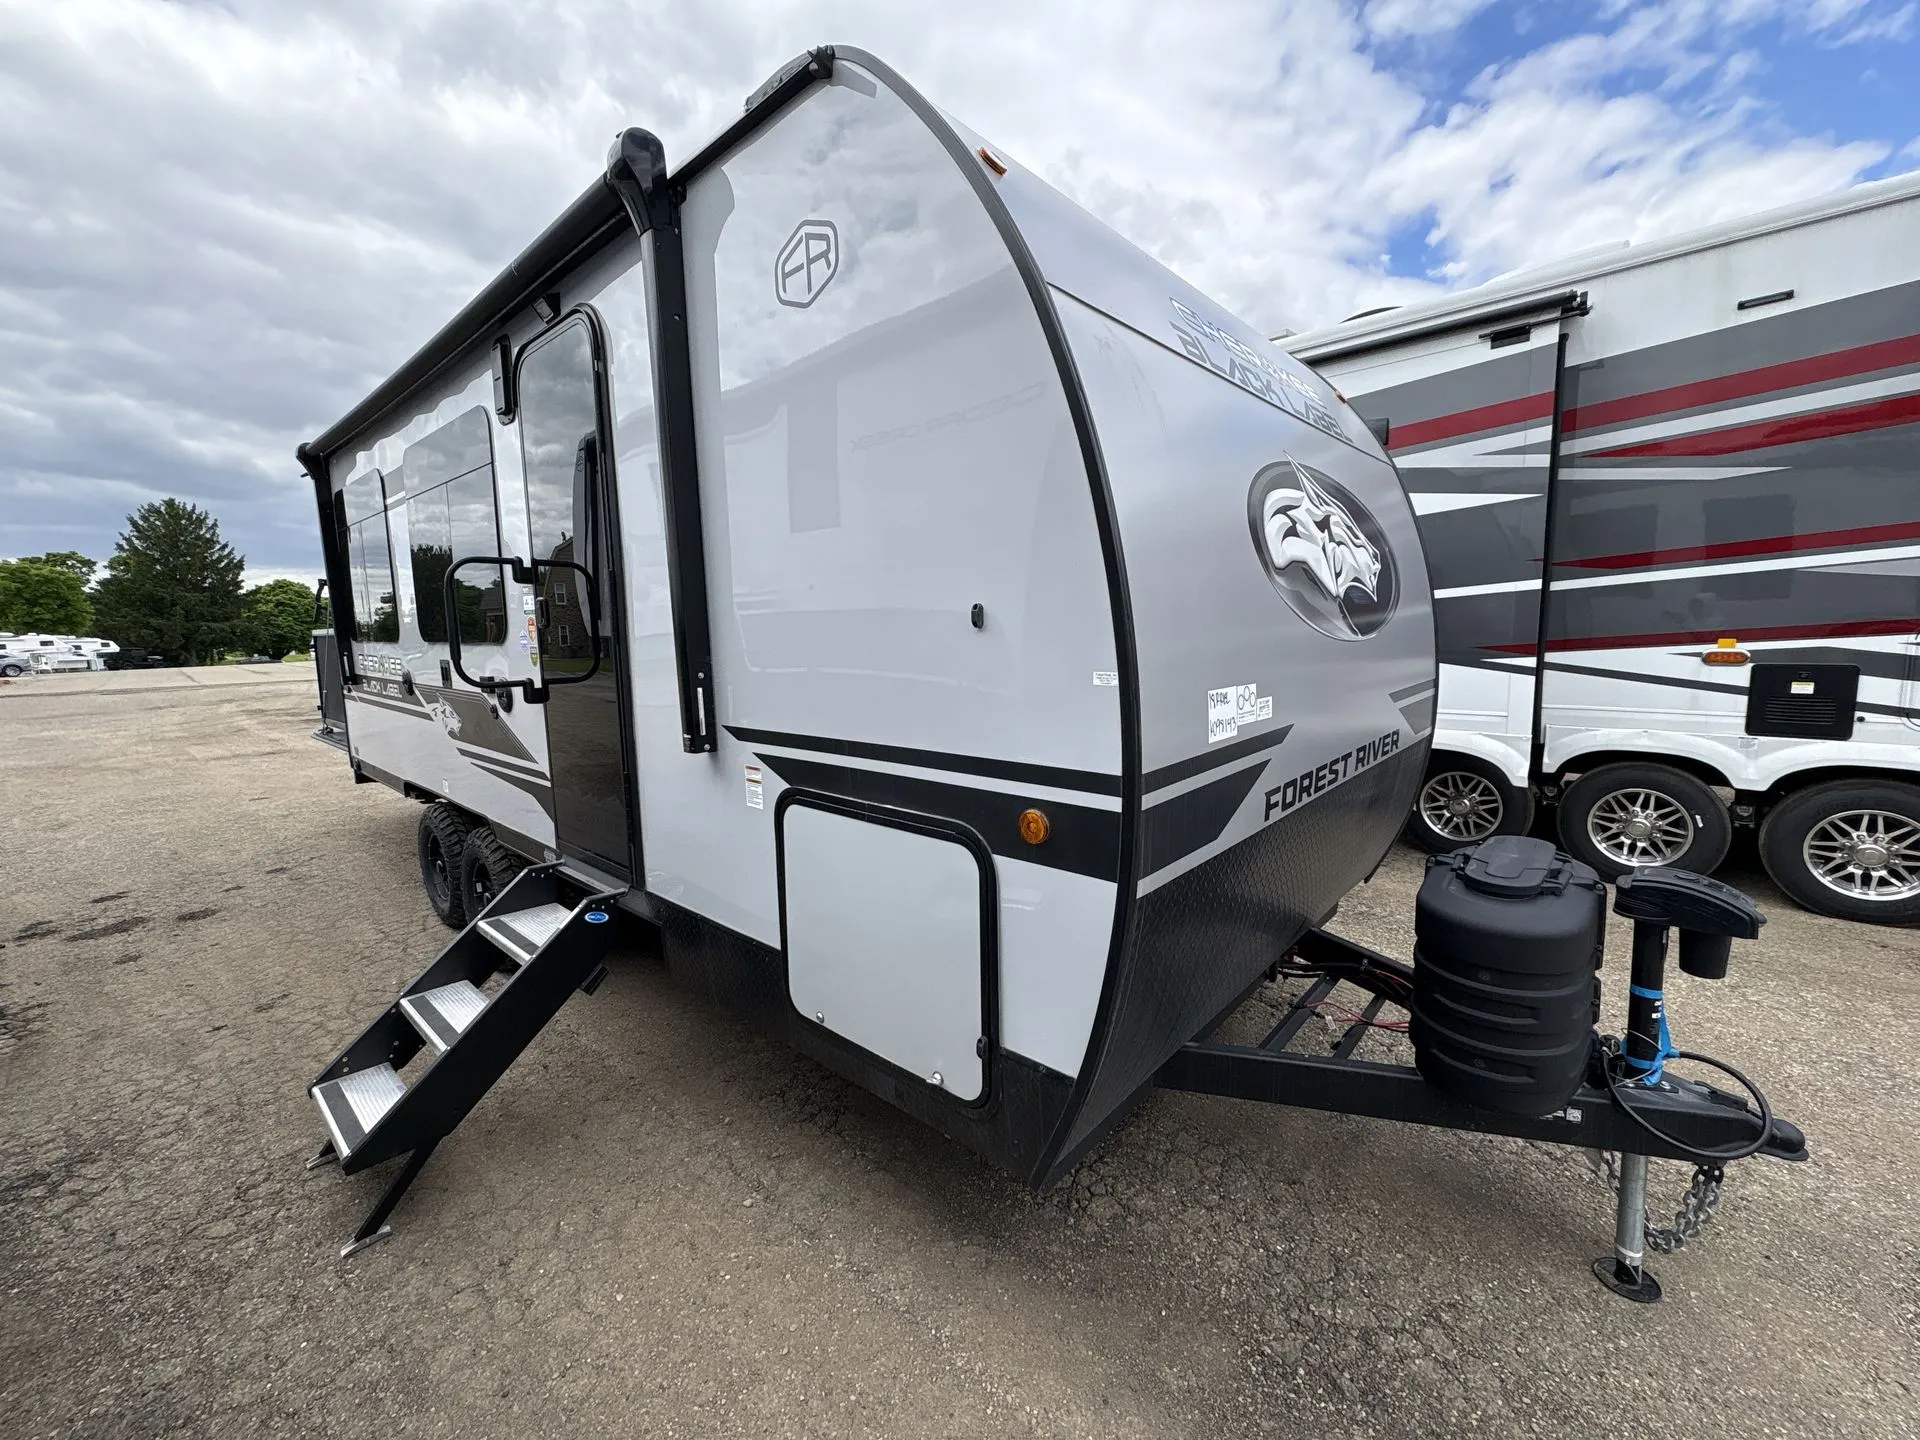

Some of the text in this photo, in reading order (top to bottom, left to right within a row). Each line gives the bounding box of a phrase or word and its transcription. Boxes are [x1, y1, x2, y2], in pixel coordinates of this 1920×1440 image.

[781, 232, 832, 295] FR
[1169, 320, 1354, 444] BLACK LABEL
[1264, 728, 1400, 823] FOREST RIVER
